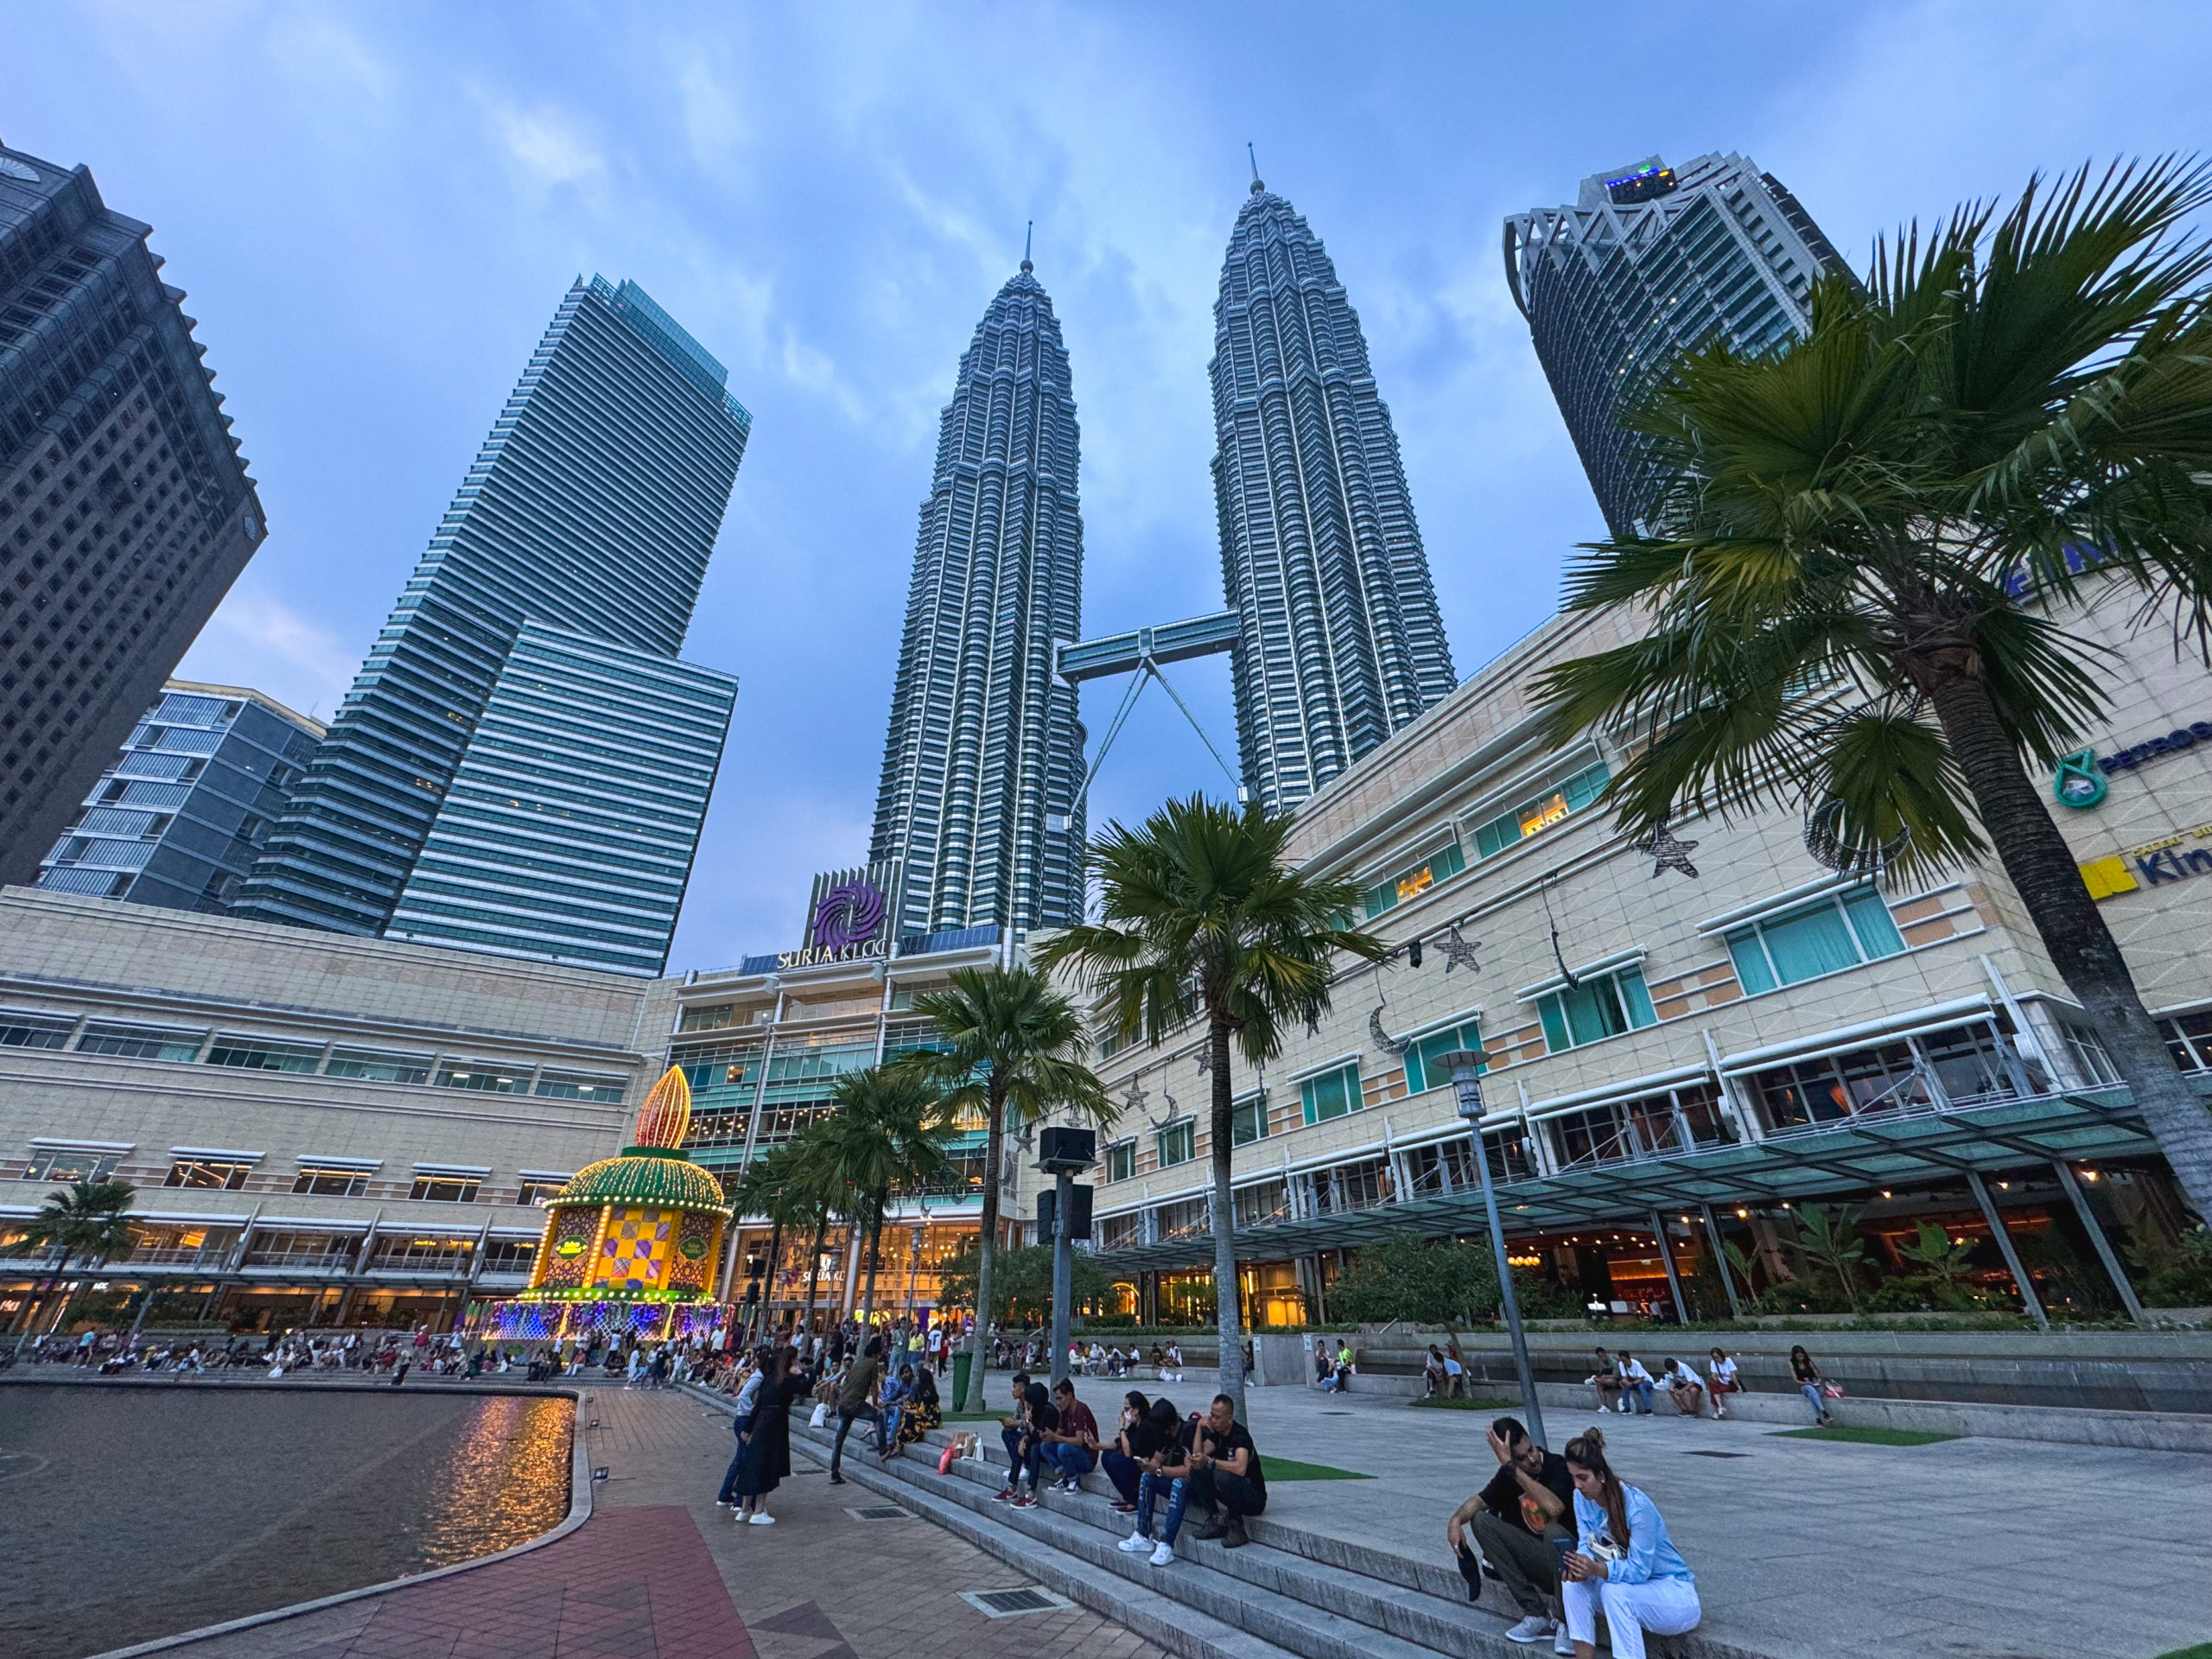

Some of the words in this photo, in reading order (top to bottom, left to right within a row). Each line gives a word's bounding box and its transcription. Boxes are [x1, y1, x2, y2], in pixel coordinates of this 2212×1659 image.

[2096, 721, 2212, 775] PETROS
[778, 945, 833, 969] SURIA
[840, 938, 887, 960] KLCC
